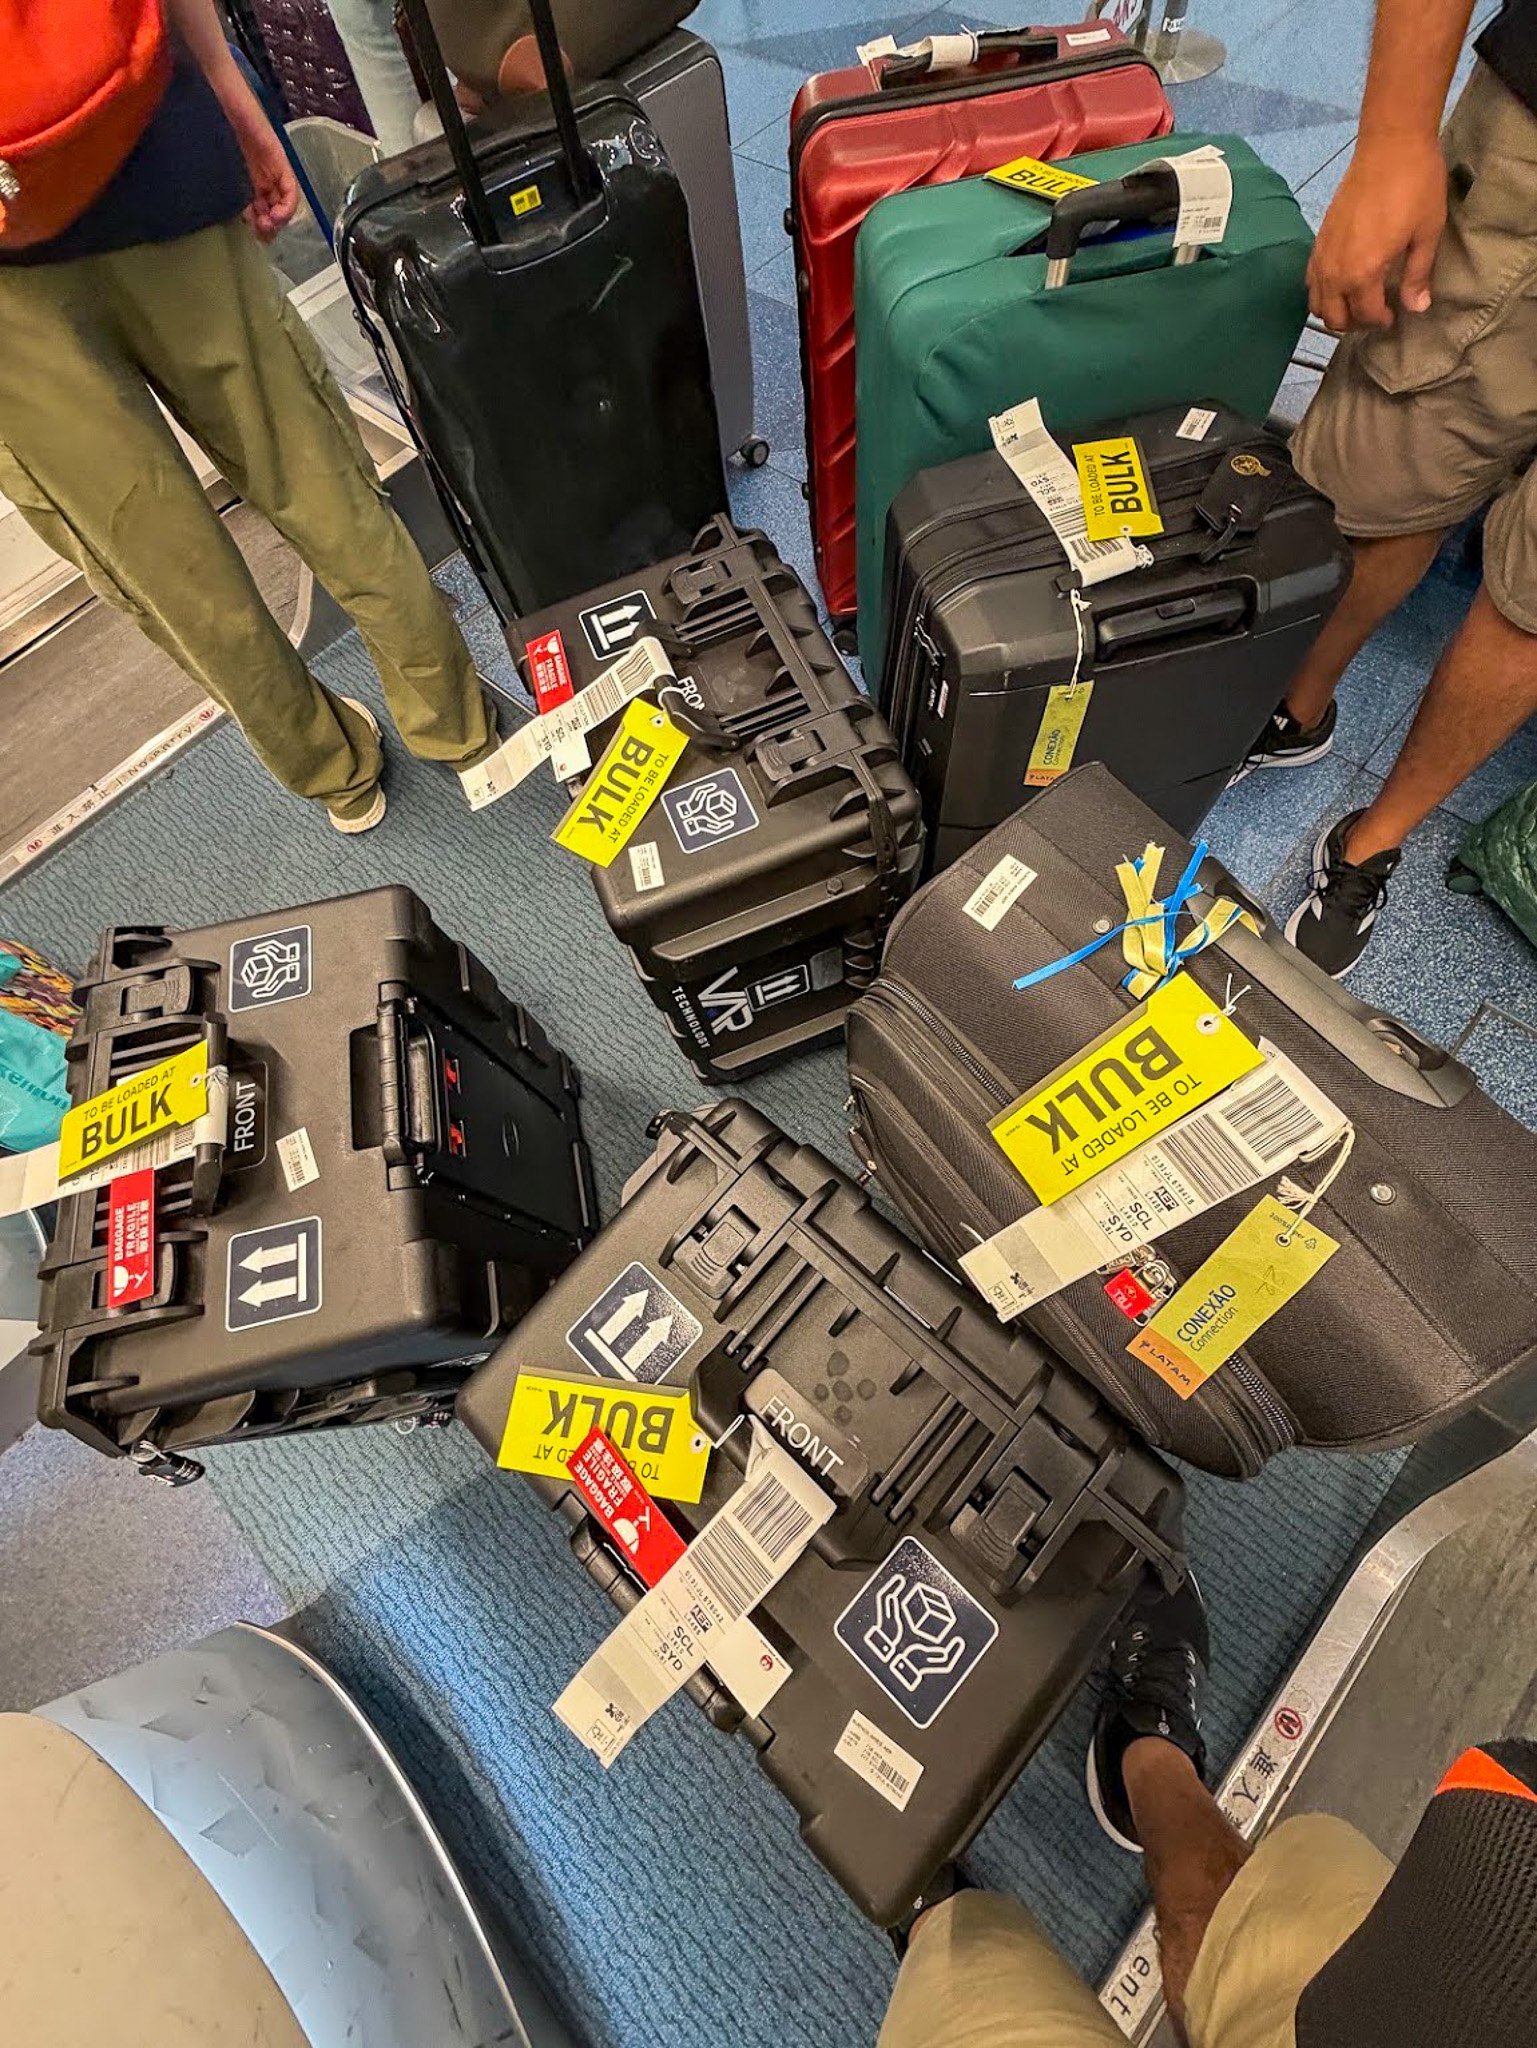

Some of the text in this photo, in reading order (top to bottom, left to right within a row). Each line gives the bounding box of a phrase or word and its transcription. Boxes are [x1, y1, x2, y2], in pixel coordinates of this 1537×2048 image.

[1085, 453, 1104, 517] TO BE LOADED AT
[1102, 450, 1143, 515] BULK
[127, 725, 192, 777] No entry
[576, 735, 655, 834] BULK
[607, 753, 669, 844] TO BE LOADED AT
[671, 986, 711, 1049] TECHNOLOGY
[83, 1066, 177, 1121] TO BE LOADED AT
[233, 1080, 256, 1152] FRONT
[1024, 1025, 1184, 1155] BULK
[80, 1083, 173, 1160] BULK
[1060, 1073, 1202, 1176] TO BE LOADED AT
[114, 1206, 125, 1261] BAGGAGE
[126, 1203, 136, 1257] FRAGILE
[1107, 1213, 1133, 1243] SYD
[1128, 1200, 1152, 1230] SCL
[1177, 1284, 1236, 1343] CONEXÃO
[1190, 1305, 1238, 1352] Connection
[1149, 1342, 1191, 1386] LATAM
[533, 1443, 551, 1460] AT
[541, 1390, 674, 1454] BULK
[761, 1396, 844, 1476] FRONT
[573, 1460, 614, 1519] BAGGAGE
[582, 1449, 624, 1507] FRAGILE
[641, 1462, 660, 1480] TO
[659, 1642, 683, 1671] SYD
[673, 1625, 695, 1657] SCL
[1110, 1955, 1151, 2017] ent
